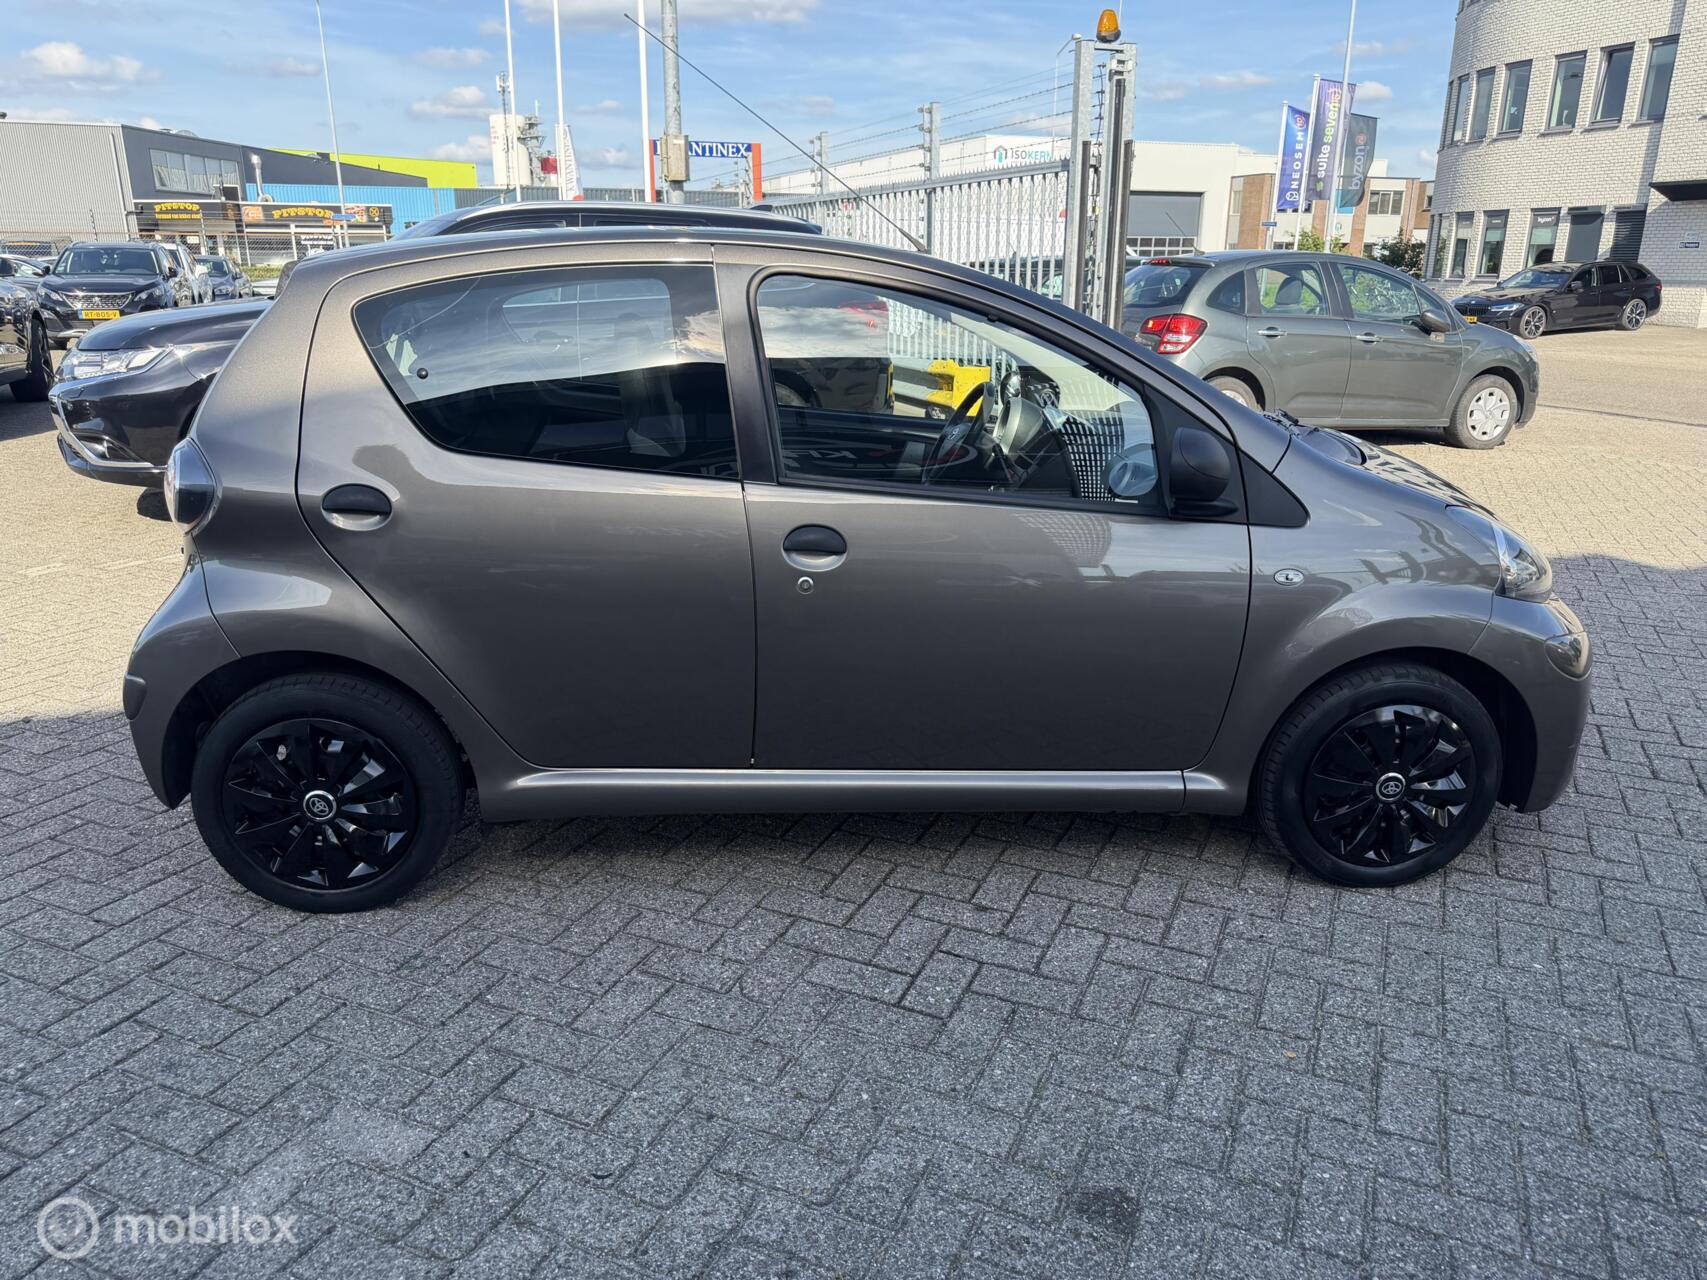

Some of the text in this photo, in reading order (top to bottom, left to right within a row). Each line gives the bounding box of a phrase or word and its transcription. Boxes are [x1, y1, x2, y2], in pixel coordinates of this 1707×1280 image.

[655, 141, 748, 157] NTINEX
[1011, 150, 1052, 160] ISOKERN
[1291, 131, 1304, 190] NEOSEM
[1317, 144, 1330, 178] suite
[1348, 145, 1364, 190] byzon
[154, 202, 200, 212] PITSTOP
[272, 207, 333, 220] PITSTOP
